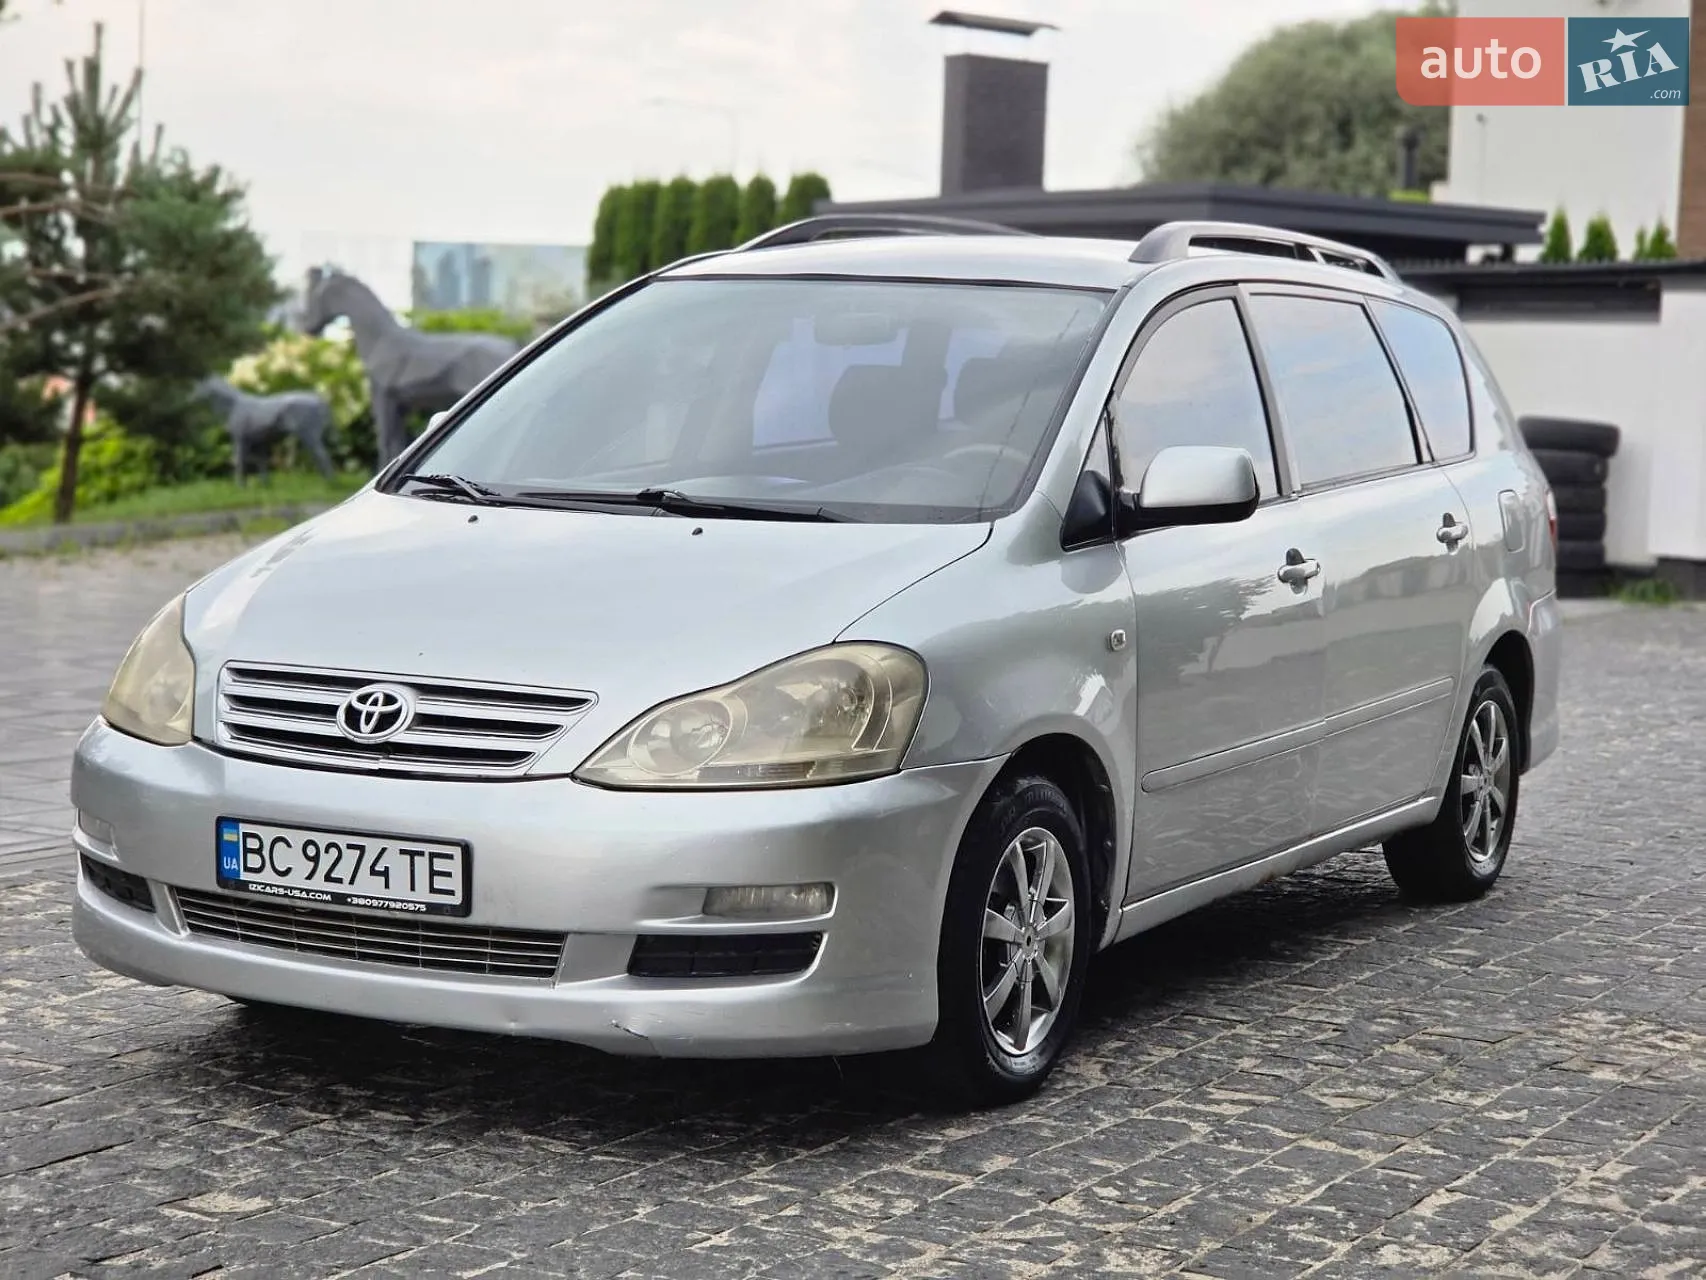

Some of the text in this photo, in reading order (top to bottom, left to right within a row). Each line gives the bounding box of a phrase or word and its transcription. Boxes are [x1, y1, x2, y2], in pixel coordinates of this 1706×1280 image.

[223, 856, 239, 870] UA
[241, 831, 456, 897] BC 9274 TE
